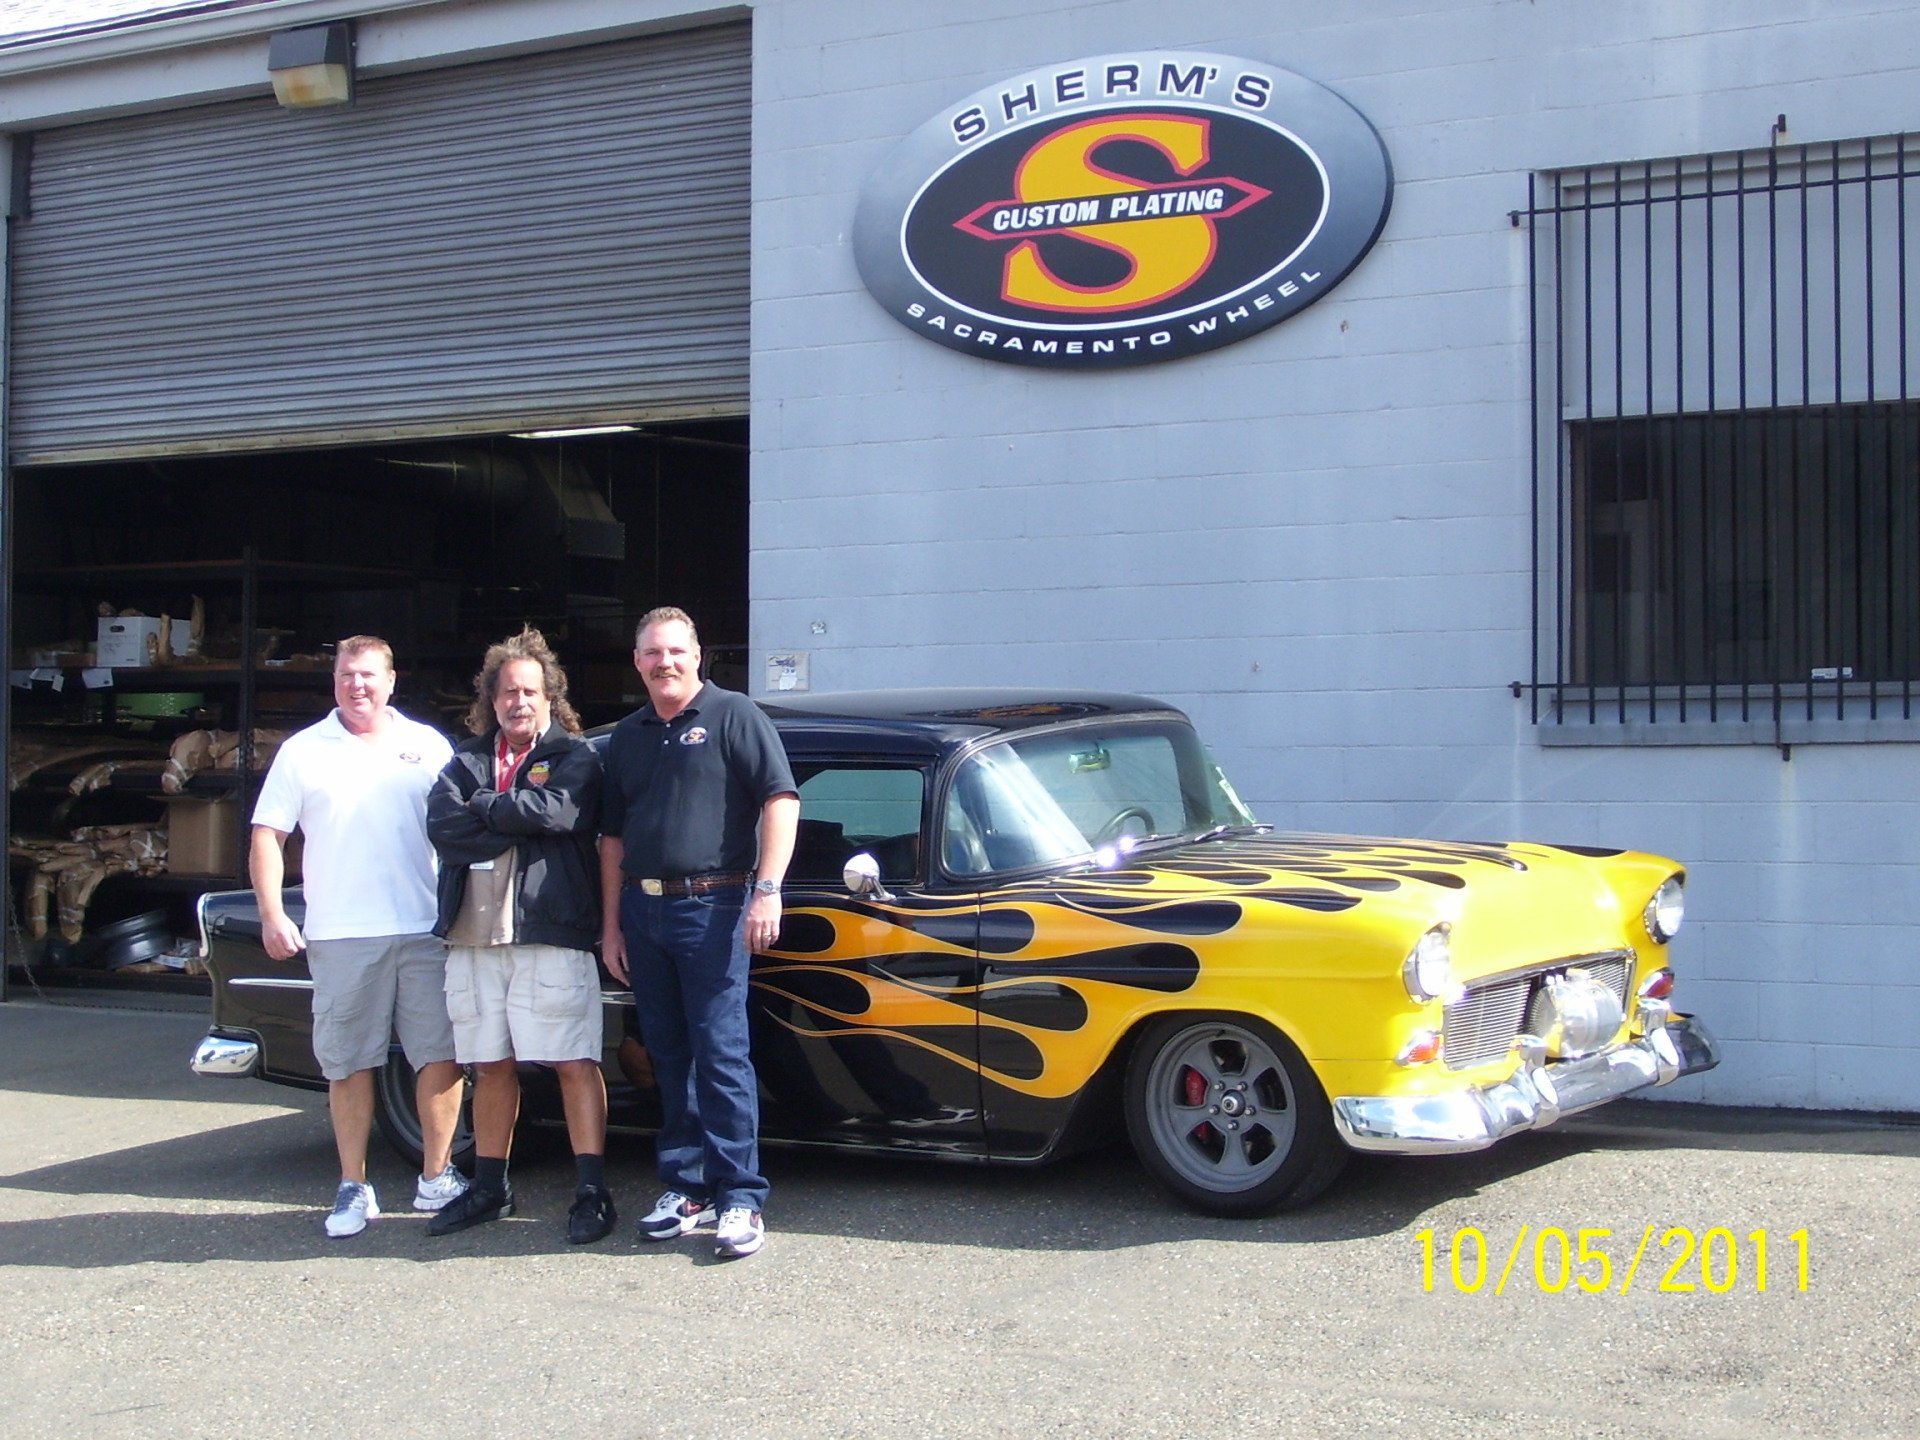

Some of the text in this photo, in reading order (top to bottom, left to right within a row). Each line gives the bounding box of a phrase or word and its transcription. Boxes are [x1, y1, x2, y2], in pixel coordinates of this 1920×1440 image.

[953, 62, 1272, 143] SHERM'S
[993, 187, 1224, 231] CUSTOM PLATING
[1000, 113, 1218, 314] S
[907, 269, 1322, 355] SACRAMENTO WHEEL
